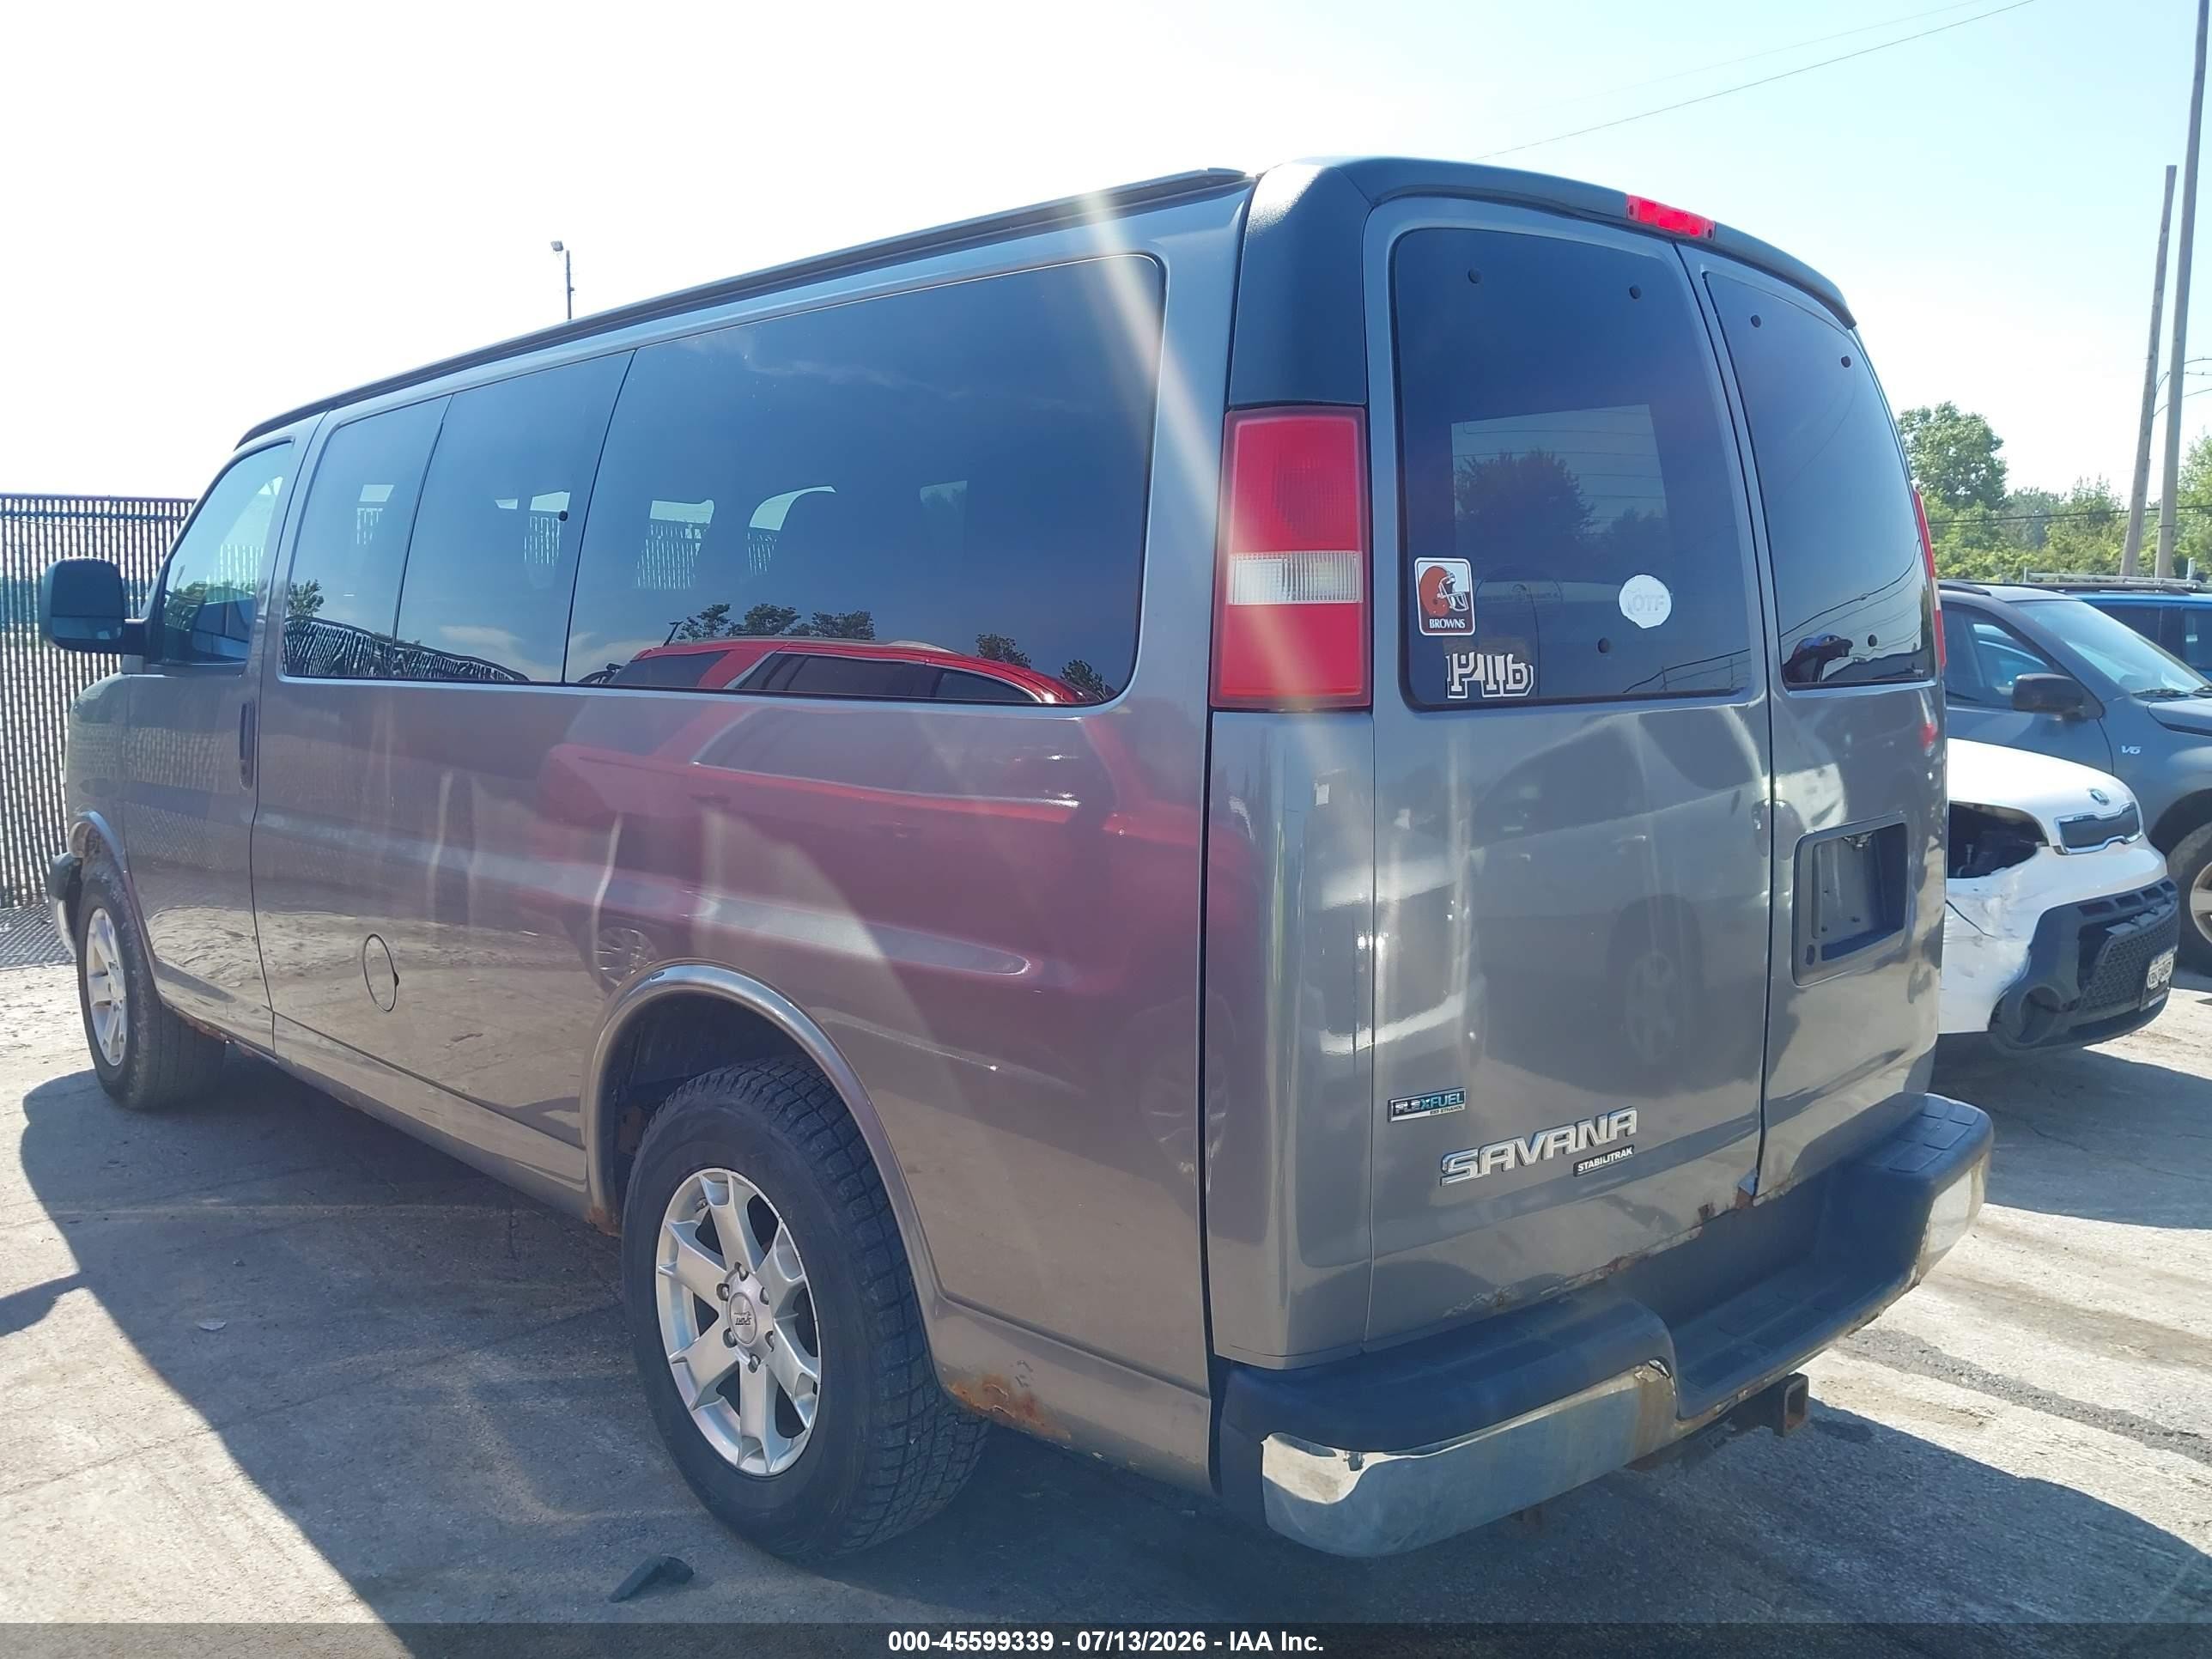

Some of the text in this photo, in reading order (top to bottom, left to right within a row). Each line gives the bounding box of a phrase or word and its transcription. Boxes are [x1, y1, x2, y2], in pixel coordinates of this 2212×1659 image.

[1429, 618, 1466, 629] BROWNS
[2121, 745, 2142, 755] V6
[1440, 1106, 1638, 1187] SAVANA
[1577, 1146, 1634, 1172] STABILITRAK
